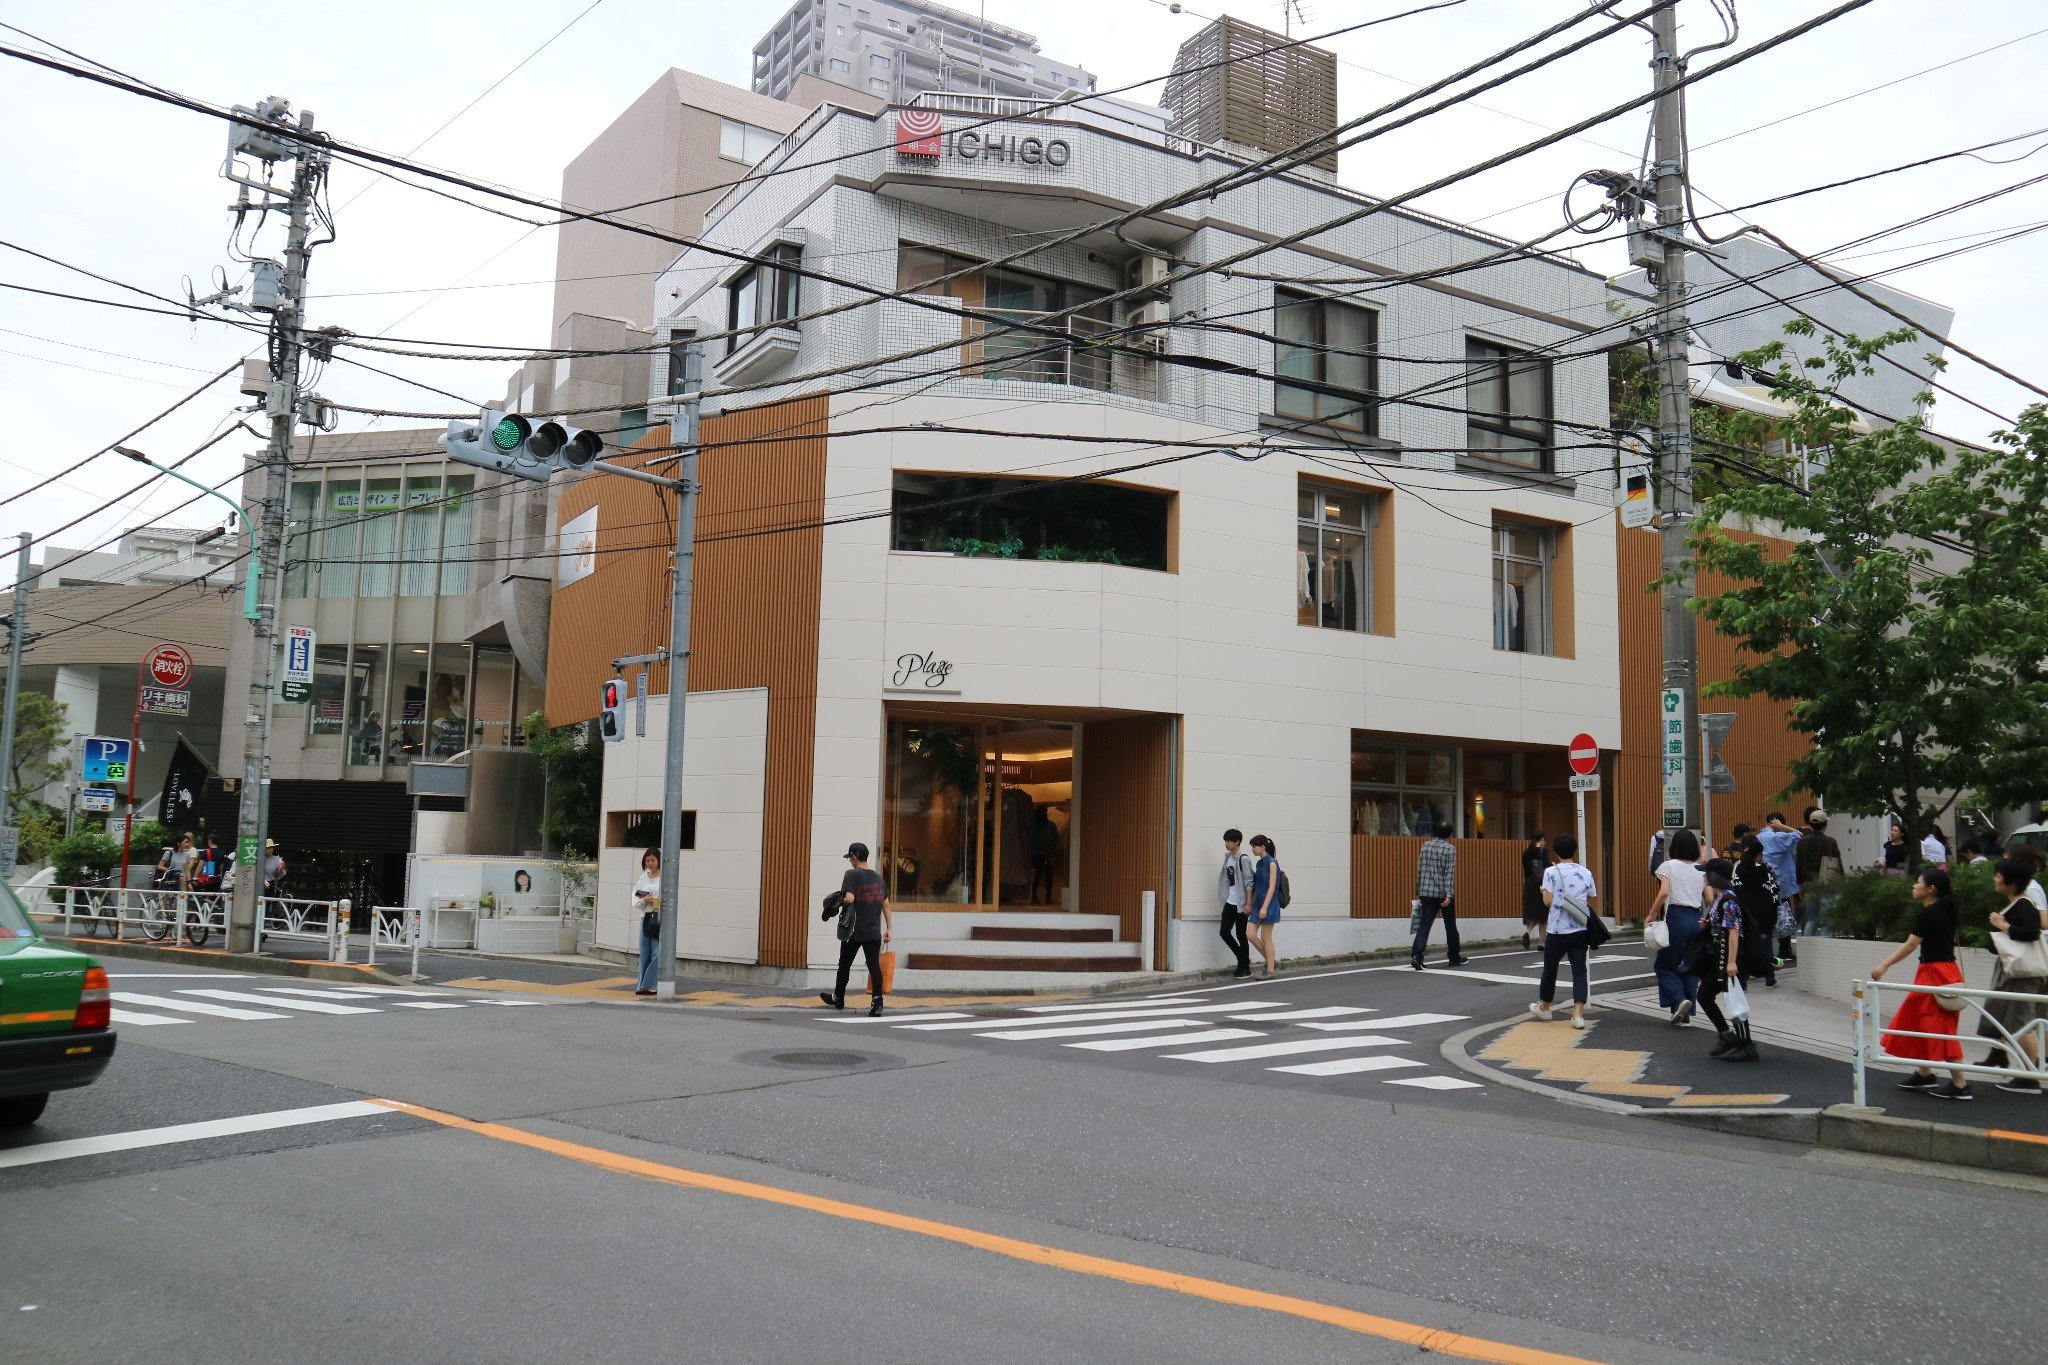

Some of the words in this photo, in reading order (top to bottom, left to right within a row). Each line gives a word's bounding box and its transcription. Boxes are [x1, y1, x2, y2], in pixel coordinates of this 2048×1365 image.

[949, 131, 1071, 167] ICHIGO
[338, 493, 387, 507] 広告とザイン
[154, 658, 184, 676] 消火栓
[292, 638, 306, 671] KEN
[893, 650, 954, 688] Plage
[143, 689, 188, 705] リキ歯科
[98, 741, 118, 761] P
[1668, 719, 1683, 774] 節歯科
[166, 772, 181, 820] LOVELESS
[243, 844, 258, 860] 文
